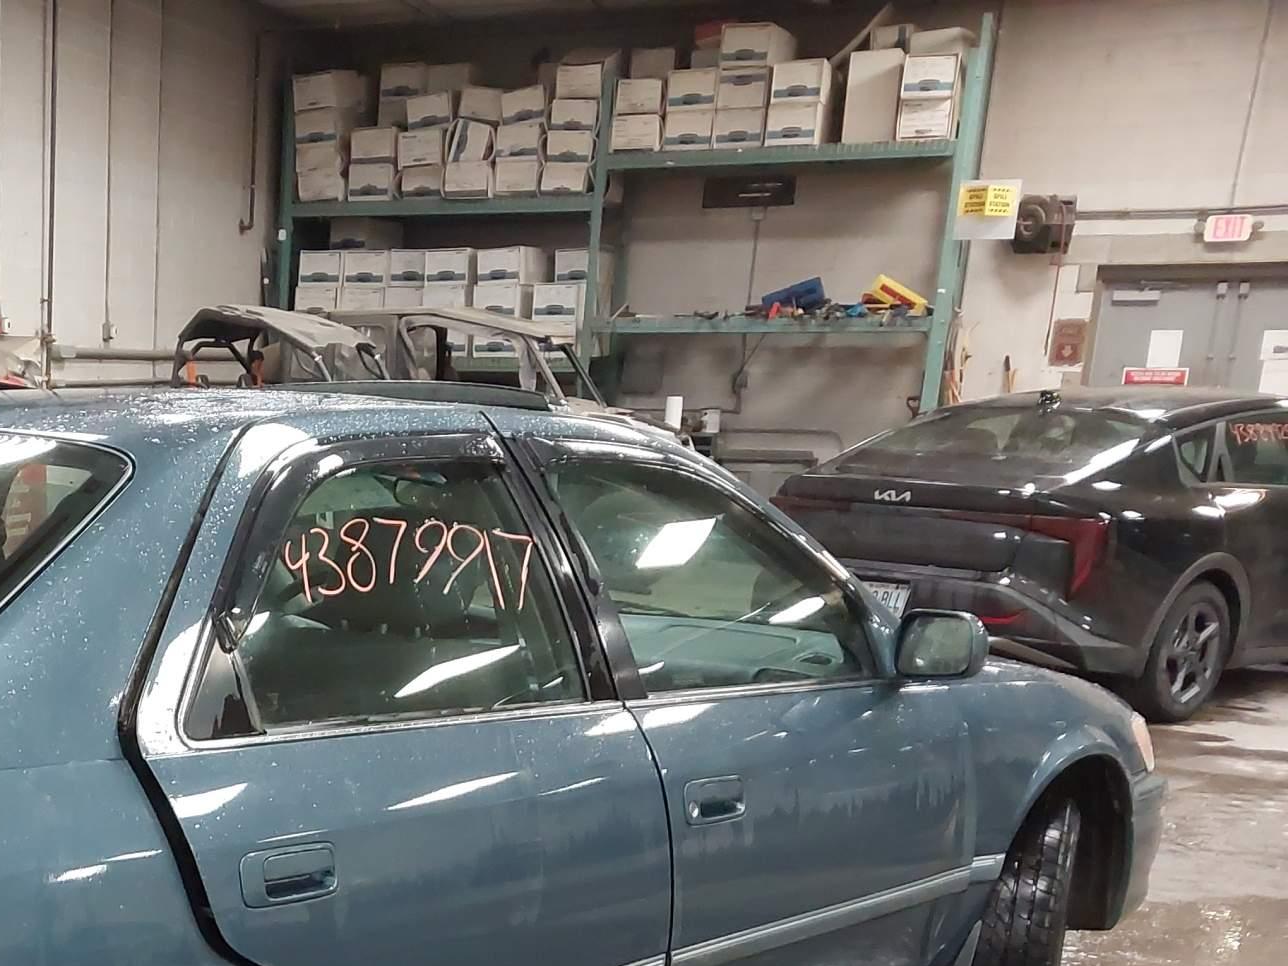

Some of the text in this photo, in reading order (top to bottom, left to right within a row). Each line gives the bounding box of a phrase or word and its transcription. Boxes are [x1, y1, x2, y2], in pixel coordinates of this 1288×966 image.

[1213, 216, 1247, 239] EXIT
[874, 489, 911, 502] KIA
[284, 517, 535, 611] 43879917
